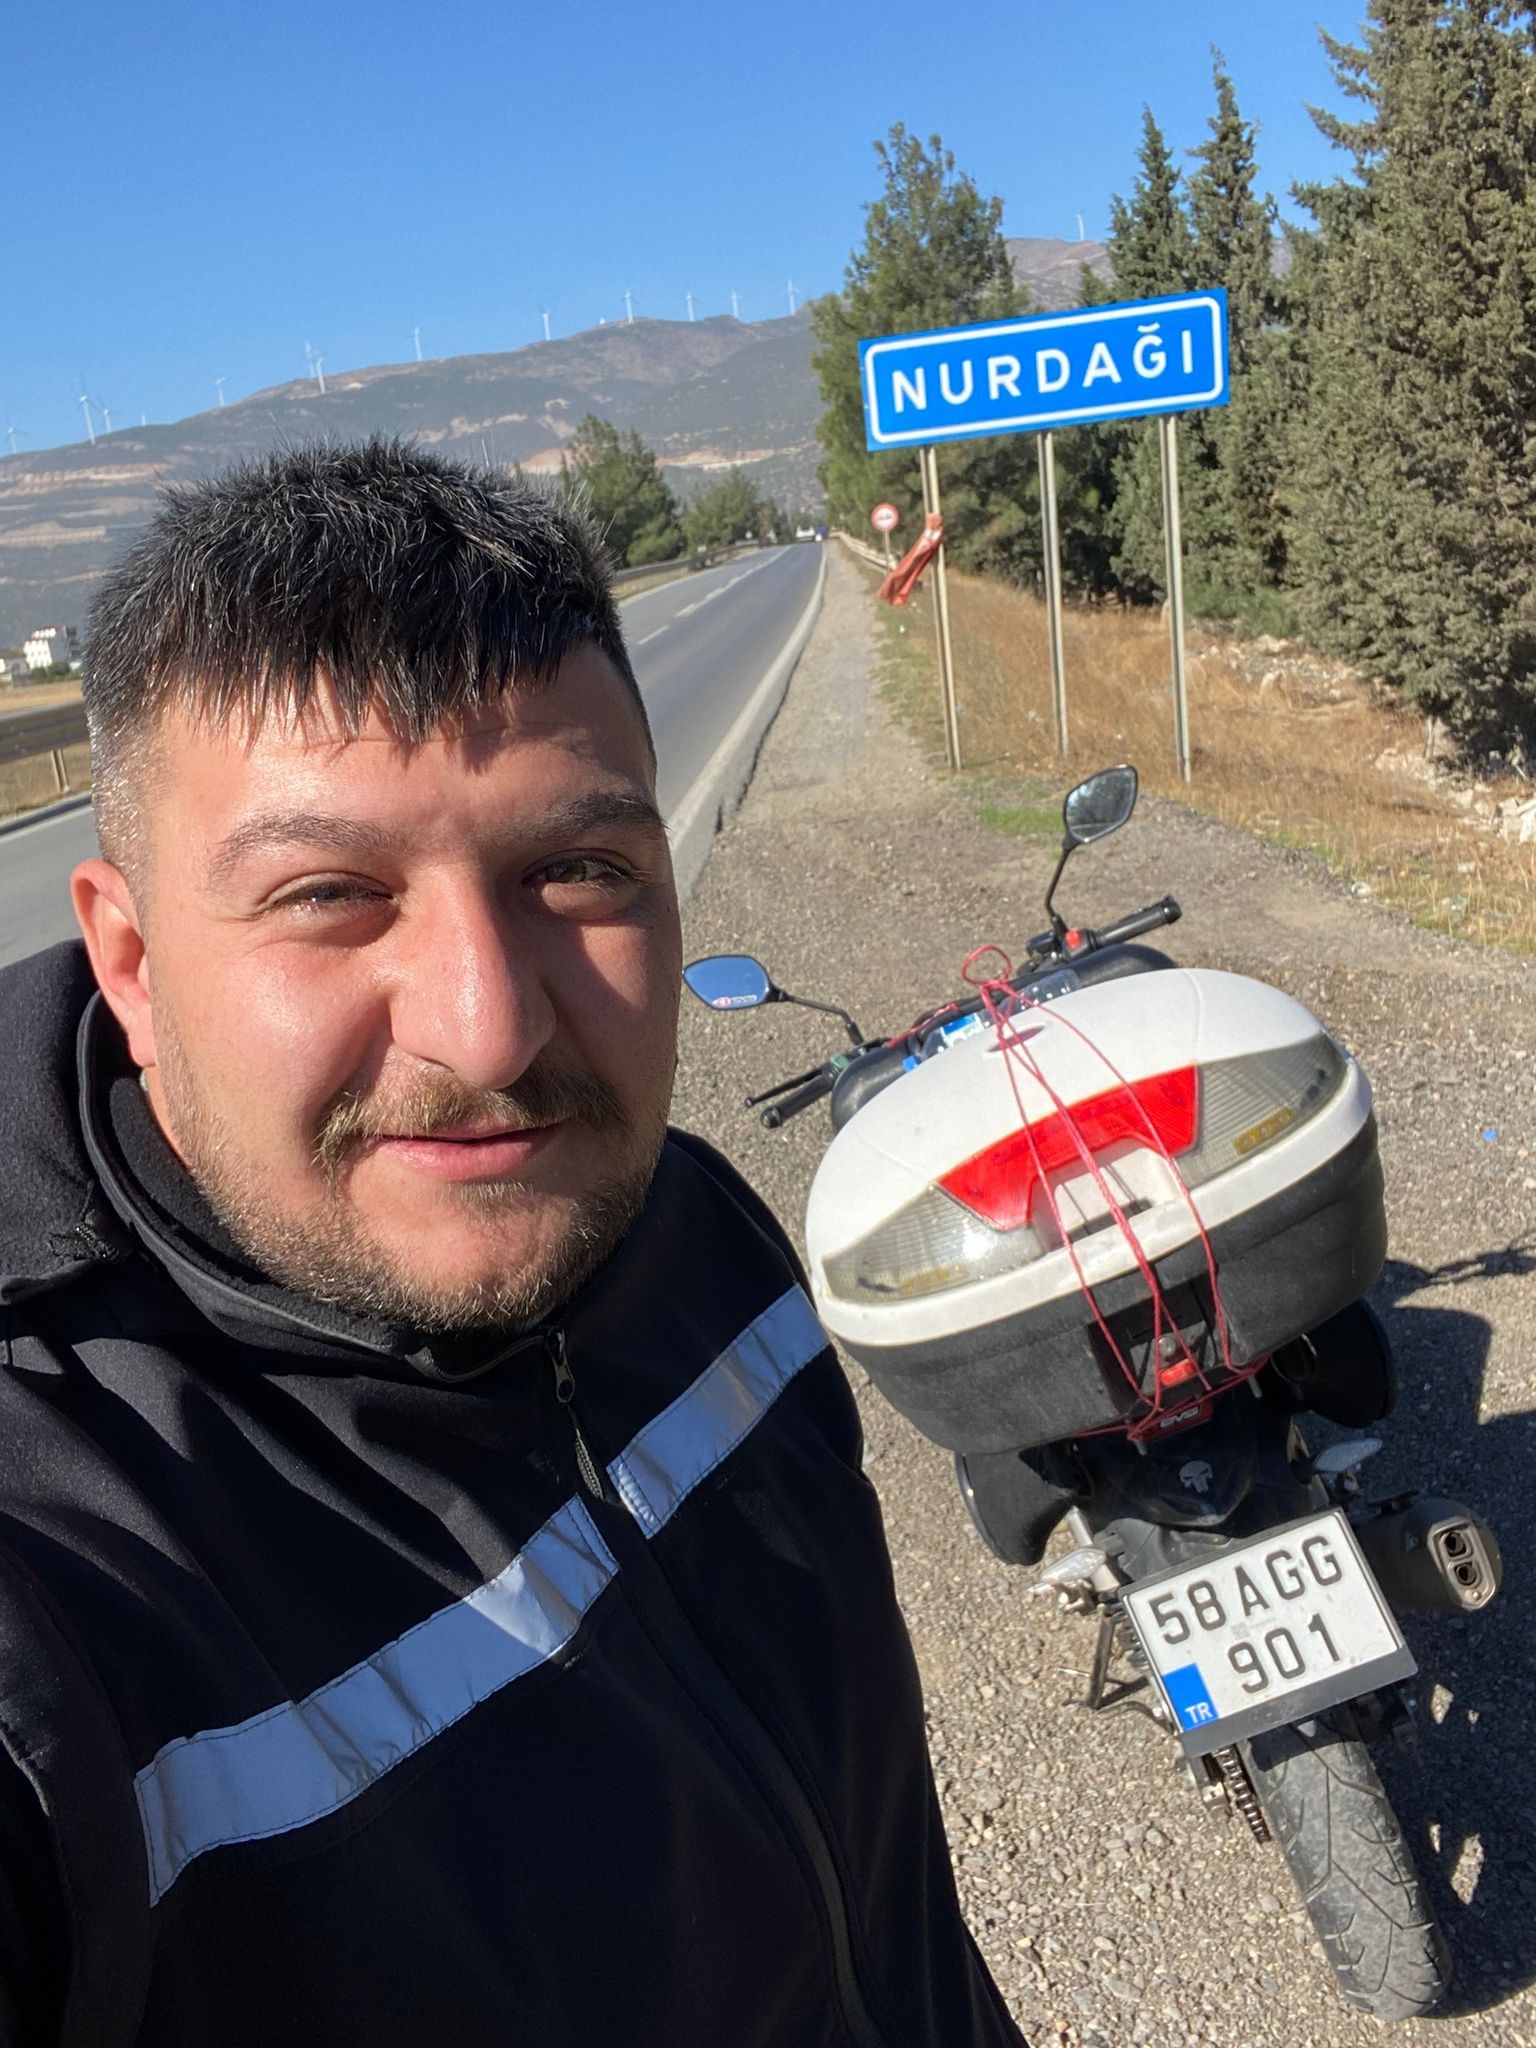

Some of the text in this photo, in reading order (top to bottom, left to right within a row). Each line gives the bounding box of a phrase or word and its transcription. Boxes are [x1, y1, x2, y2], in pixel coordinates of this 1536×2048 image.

[891, 322, 1193, 413] NURDAĞI
[1148, 1535, 1342, 1645] 58 AGG
[1227, 1613, 1341, 1694] 901
[1185, 1701, 1213, 1724] TR
